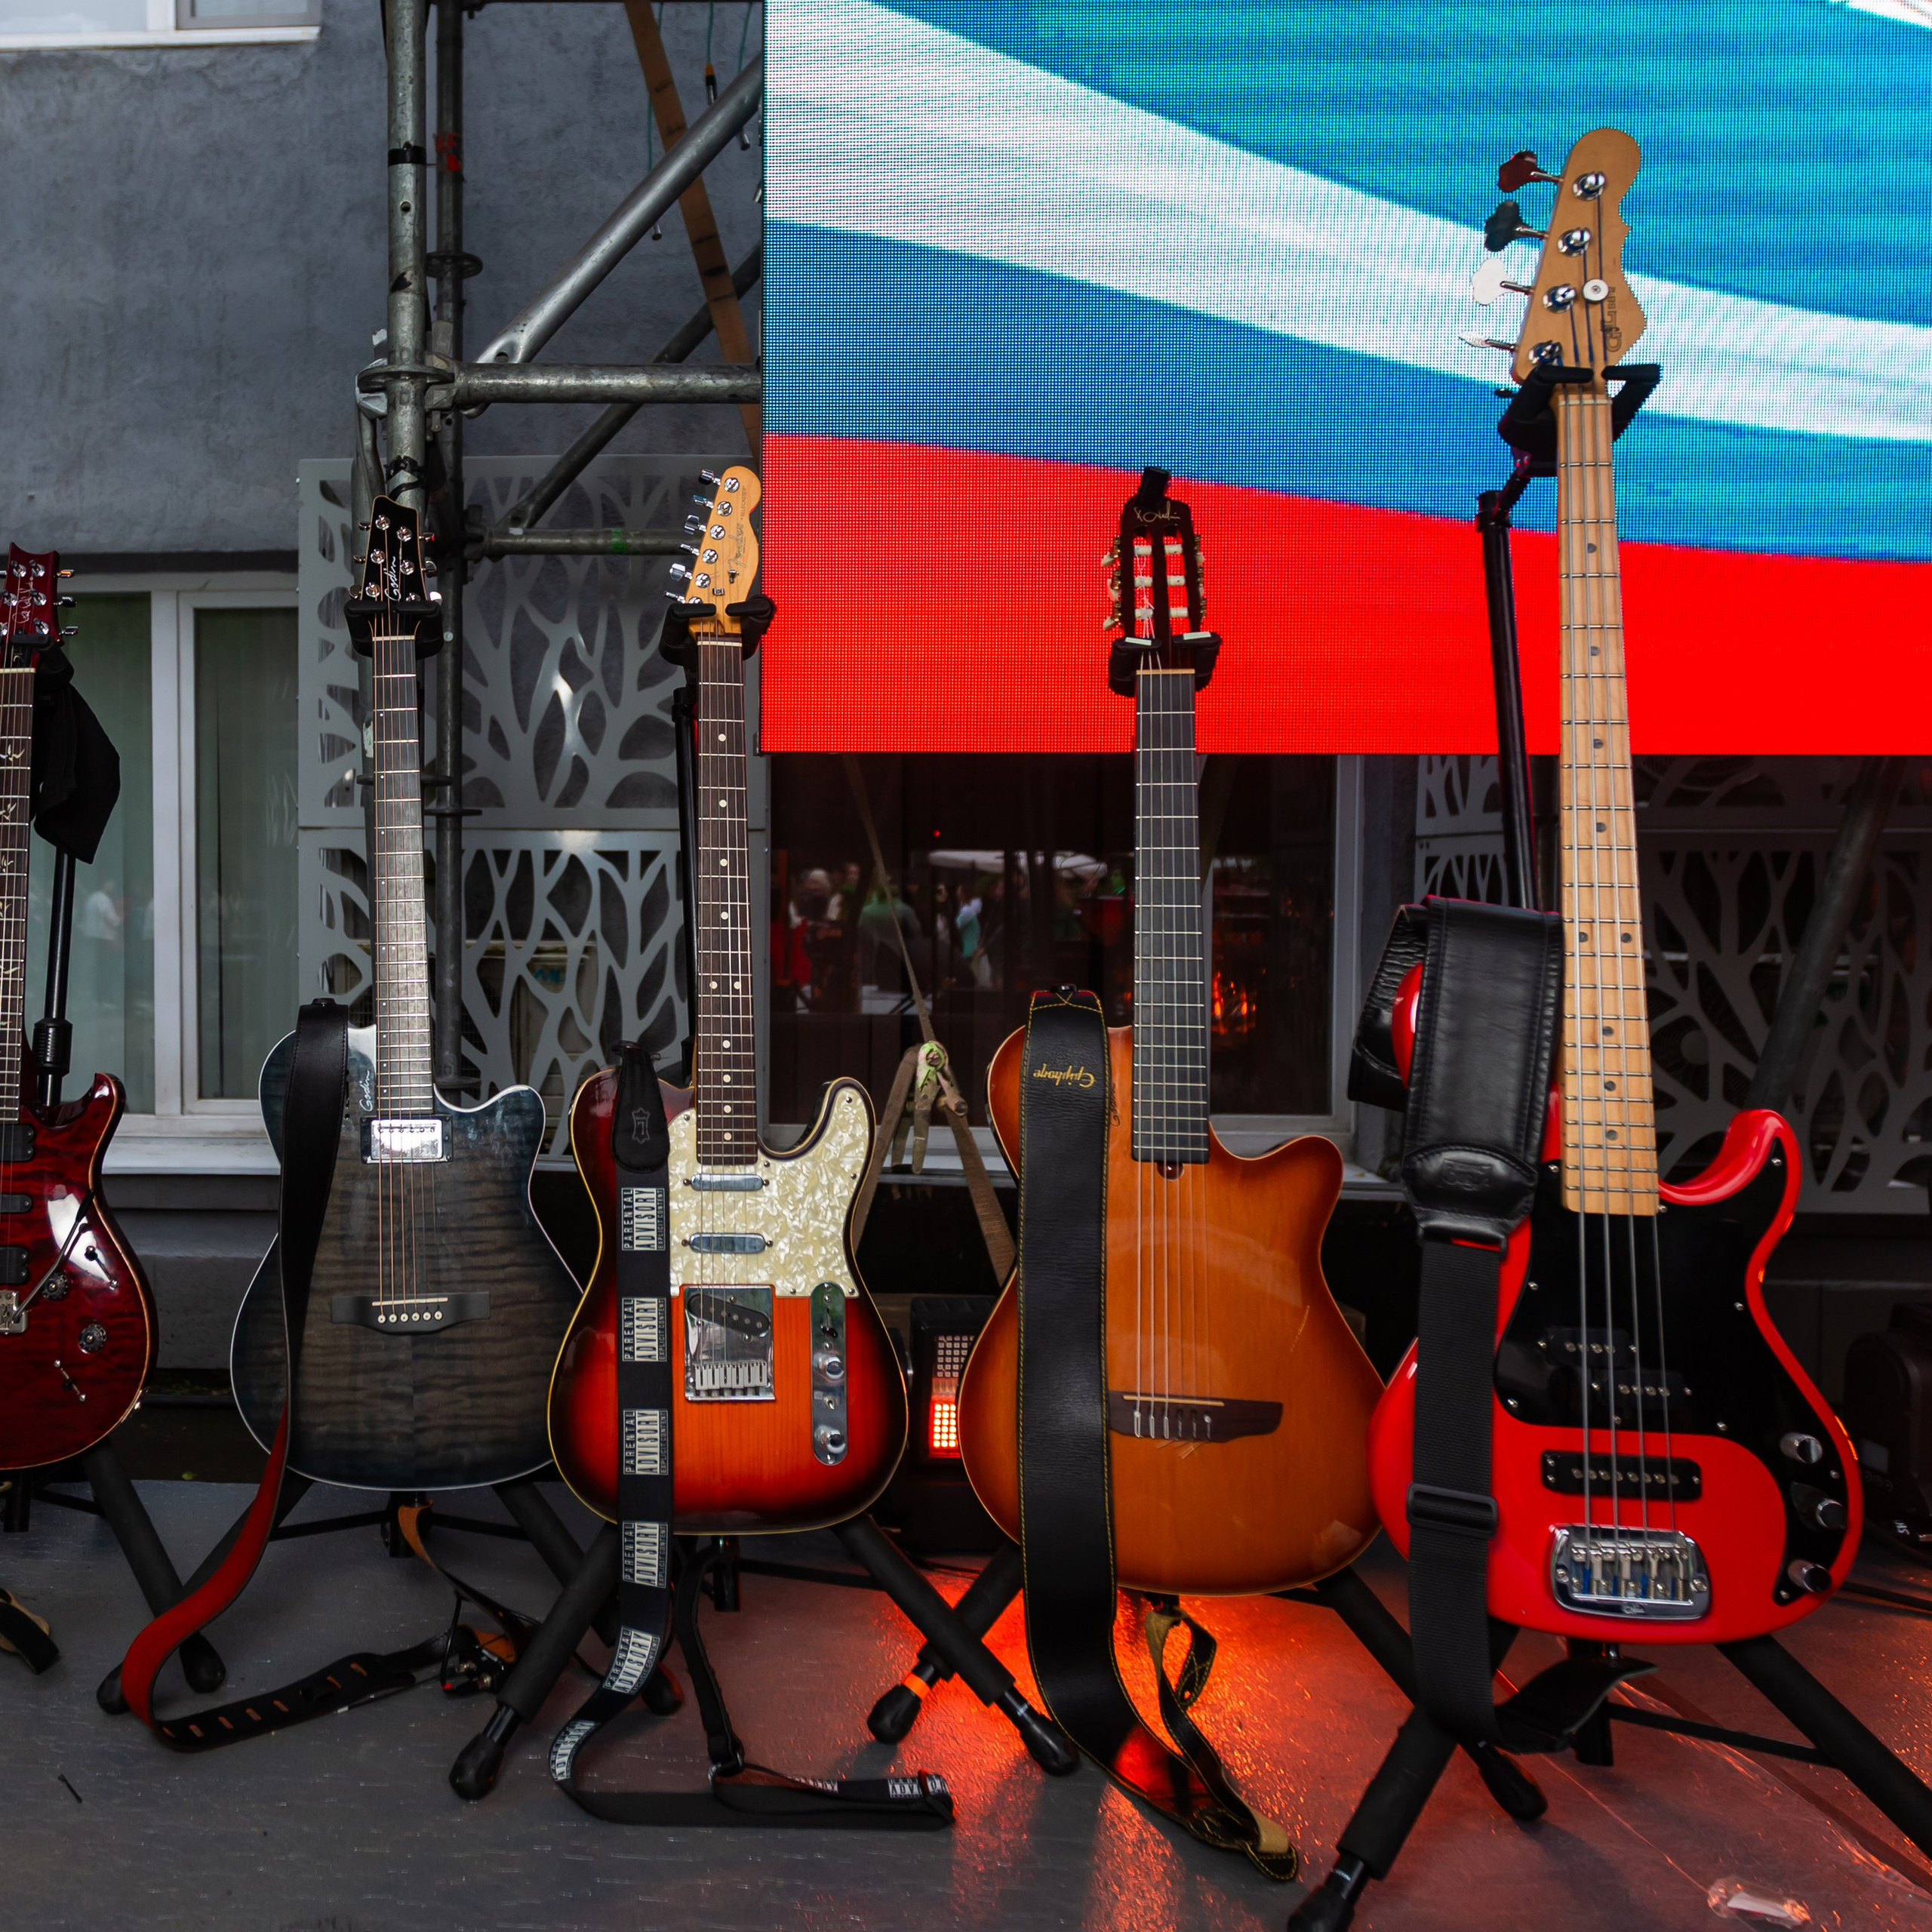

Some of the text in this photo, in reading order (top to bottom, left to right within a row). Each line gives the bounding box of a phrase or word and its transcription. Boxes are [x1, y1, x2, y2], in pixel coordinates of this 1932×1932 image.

[728, 523, 746, 569] Fender
[383, 555, 401, 601] Godin
[359, 1070, 374, 1112] Godin
[1033, 1063, 1097, 1088] Epiphone
[624, 1189, 633, 1249] PARENTAL
[635, 1189, 655, 1250] ADVISORY
[624, 1300, 633, 1359] PARENTAL
[635, 1300, 656, 1360] ADVISORY
[625, 1411, 635, 1472] PARENTAL
[637, 1412, 657, 1473] ADVISORY
[624, 1523, 634, 1580] PARENTAL
[636, 1525, 657, 1585] ADVISORY
[605, 1630, 631, 1687] PARENTAL
[614, 1632, 651, 1692] ADVISORY
[557, 1722, 593, 1777] ADVISORY
